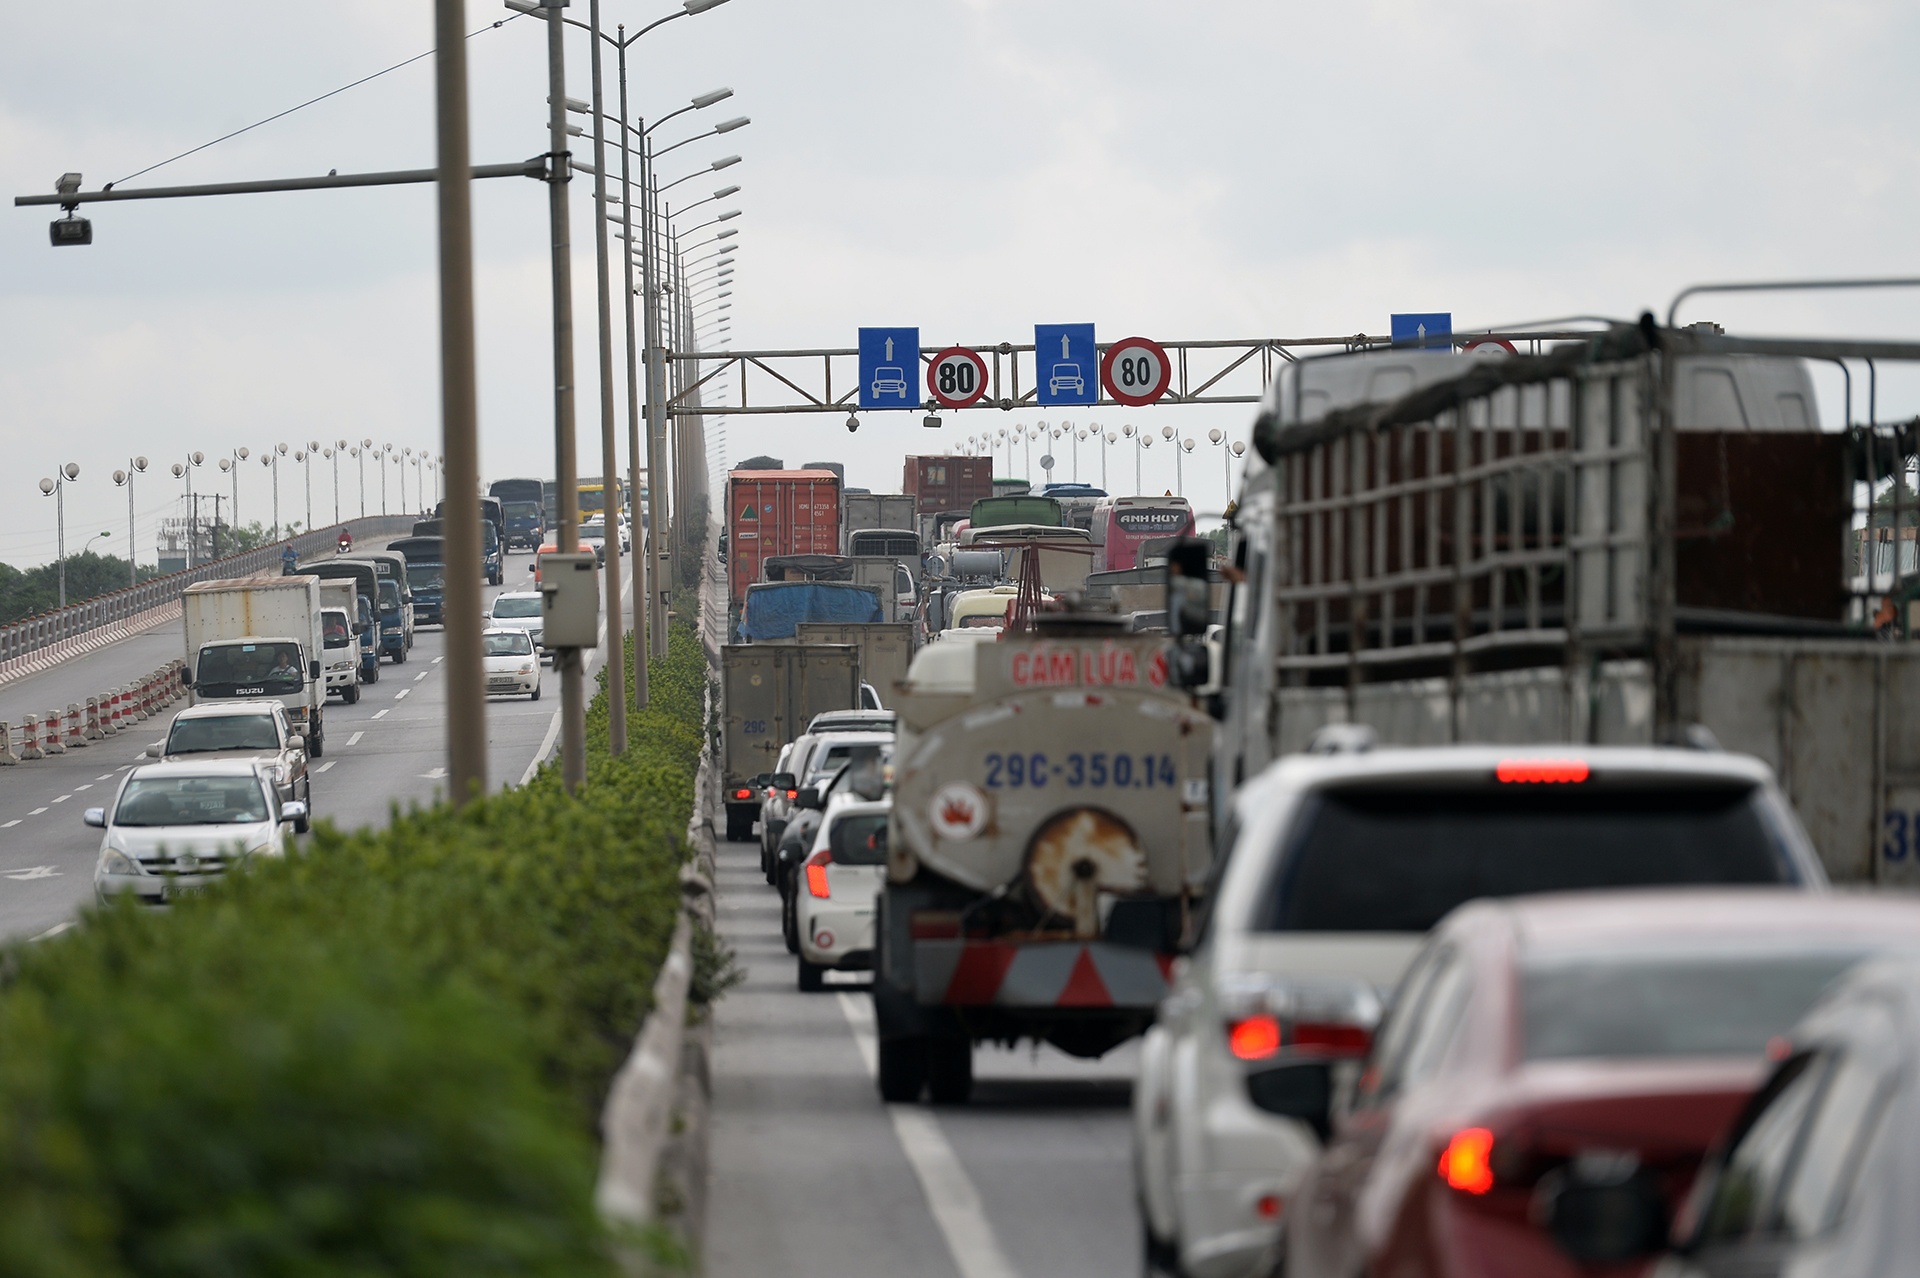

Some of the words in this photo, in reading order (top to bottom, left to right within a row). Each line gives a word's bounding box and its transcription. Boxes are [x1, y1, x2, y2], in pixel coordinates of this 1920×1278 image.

[938, 362, 975, 394] 80
[1121, 357, 1151, 387] 80
[1120, 514, 1149, 523] ANH
[1151, 514, 1180, 523] HUY
[235, 687, 264, 695] ISUZU
[744, 720, 766, 734] 29C
[985, 752, 1177, 789] 29C-350.14
